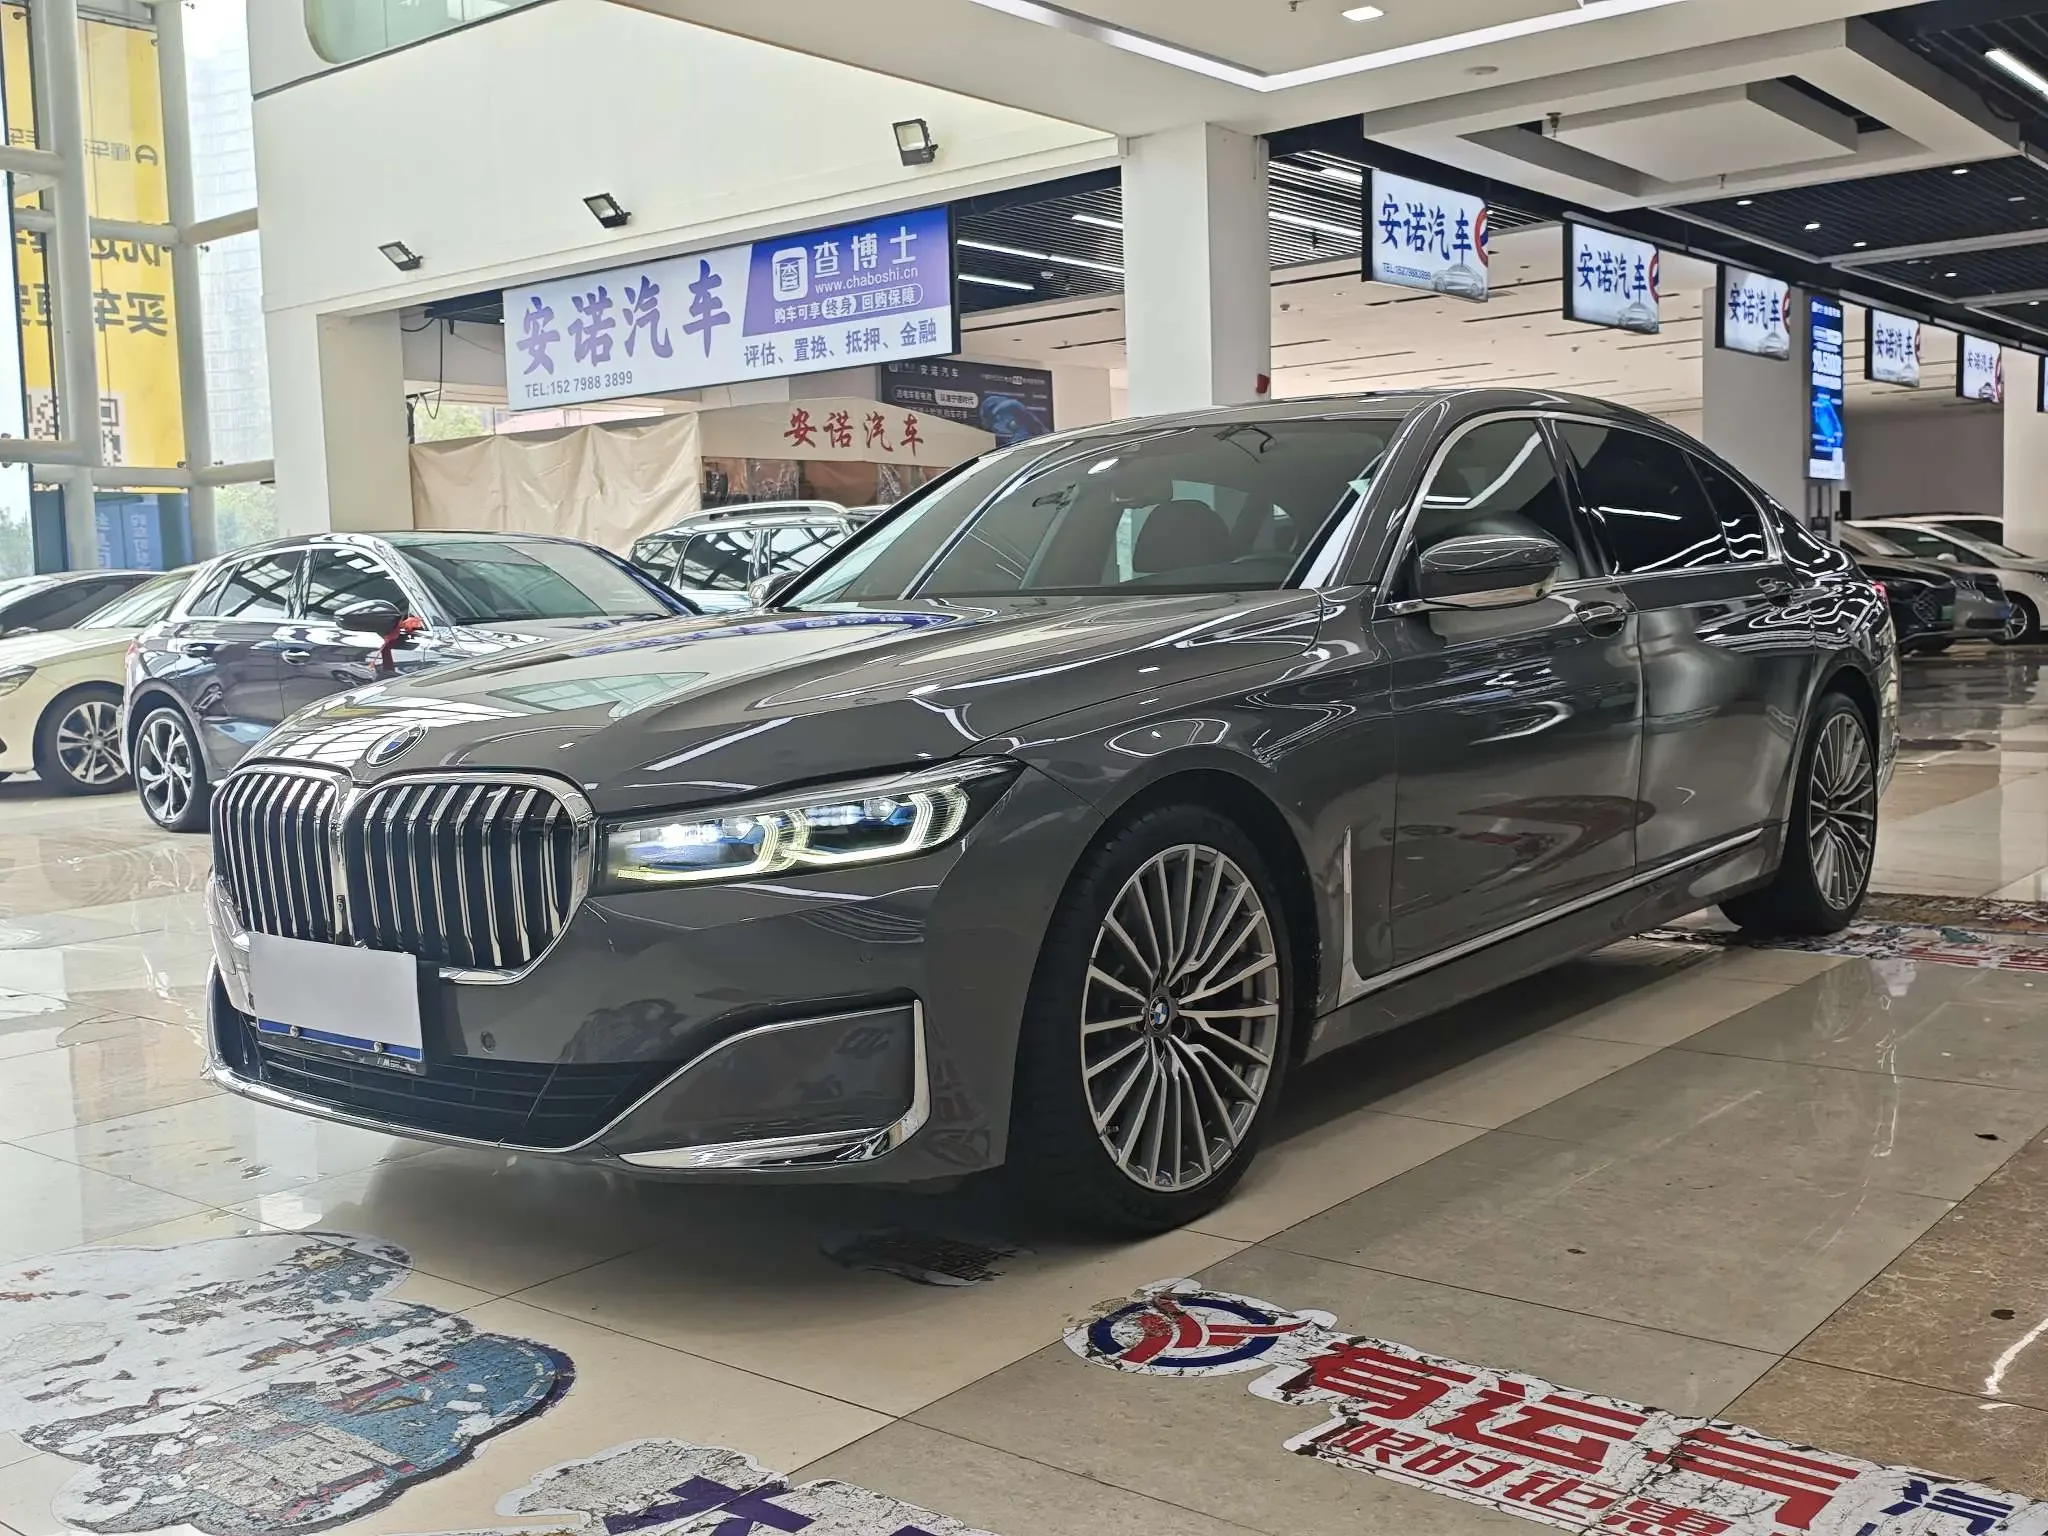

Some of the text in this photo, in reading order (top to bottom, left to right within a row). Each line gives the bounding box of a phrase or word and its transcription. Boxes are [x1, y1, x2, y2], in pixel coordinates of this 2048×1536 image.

[814, 226, 918, 278] 查博士
[1378, 193, 1472, 265] 安诺汽车
[815, 267, 918, 294] www.chaboshi.cn
[1577, 244, 1647, 303] 安诺汽车
[516, 259, 731, 376] 安诺汽车
[1728, 283, 1780, 331] 安诺汽车
[1875, 324, 1913, 363] 安诺汽车
[574, 375, 601, 392] 7988
[605, 370, 633, 388] 3899
[784, 408, 924, 456] 安诺汽车
